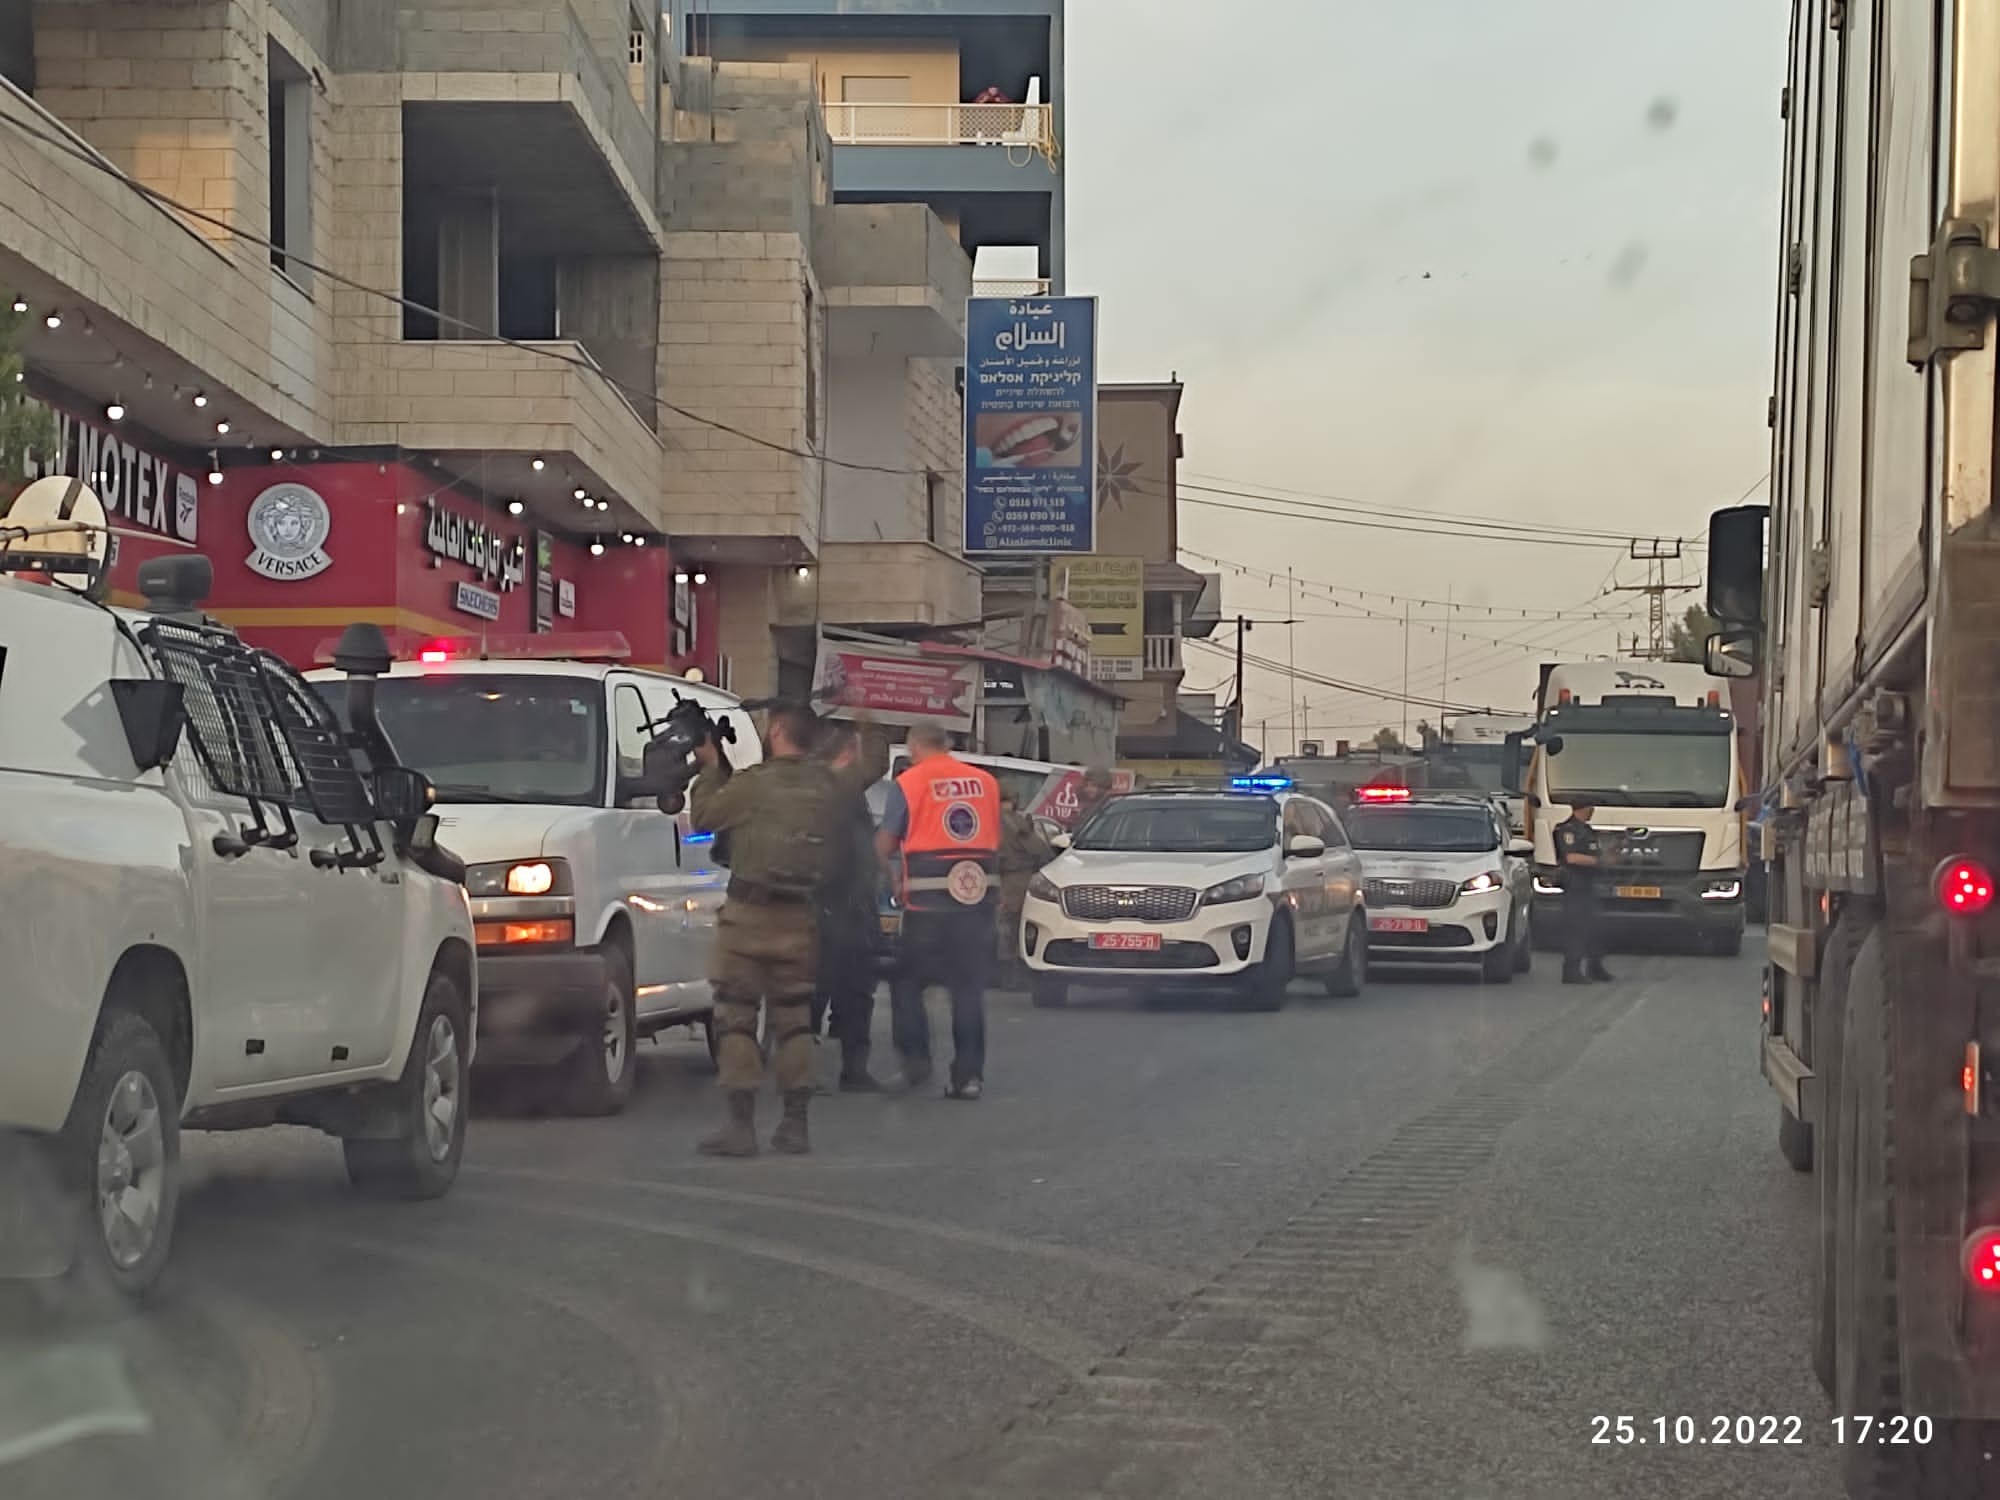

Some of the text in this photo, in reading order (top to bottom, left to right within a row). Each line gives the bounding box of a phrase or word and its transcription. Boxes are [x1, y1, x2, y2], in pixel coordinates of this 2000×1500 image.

[1009, 299, 1053, 319] عيادة
[995, 321, 1065, 351] السلام
[1029, 369, 1081, 386] קליניקת
[77, 418, 168, 533] MOTEX
[257, 552, 324, 577] VERSACE
[934, 780, 983, 797] חובש
